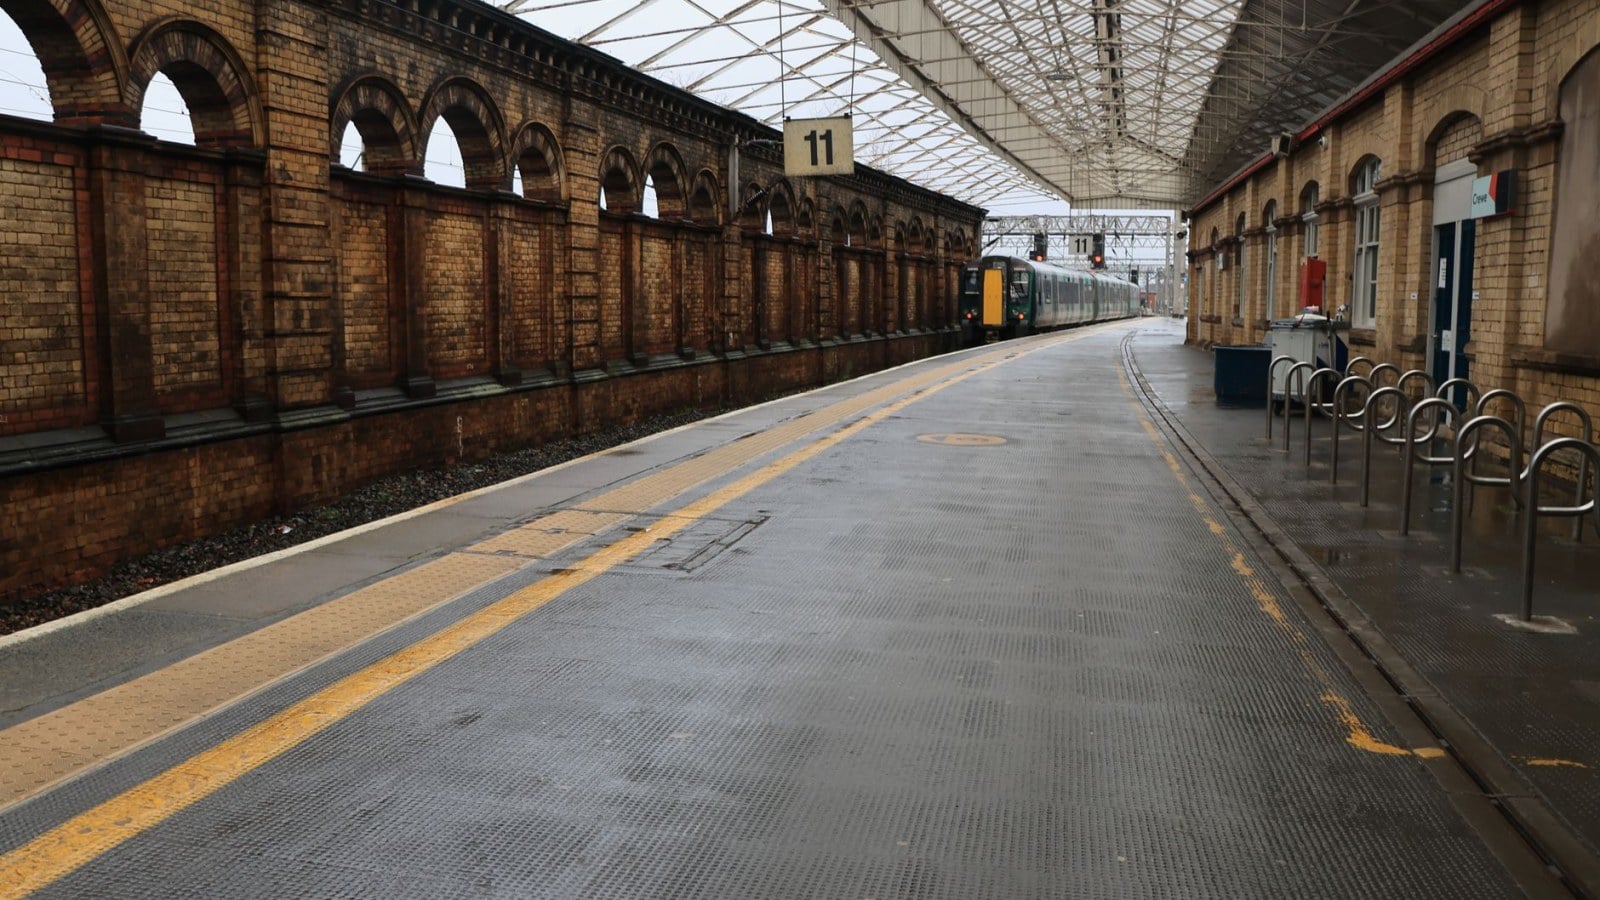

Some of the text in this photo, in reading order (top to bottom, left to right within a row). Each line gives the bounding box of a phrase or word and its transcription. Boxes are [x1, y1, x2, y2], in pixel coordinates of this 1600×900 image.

[804, 129, 833, 166] 11
[1472, 193, 1488, 205] Crewe
[1075, 238, 1087, 253] 11
